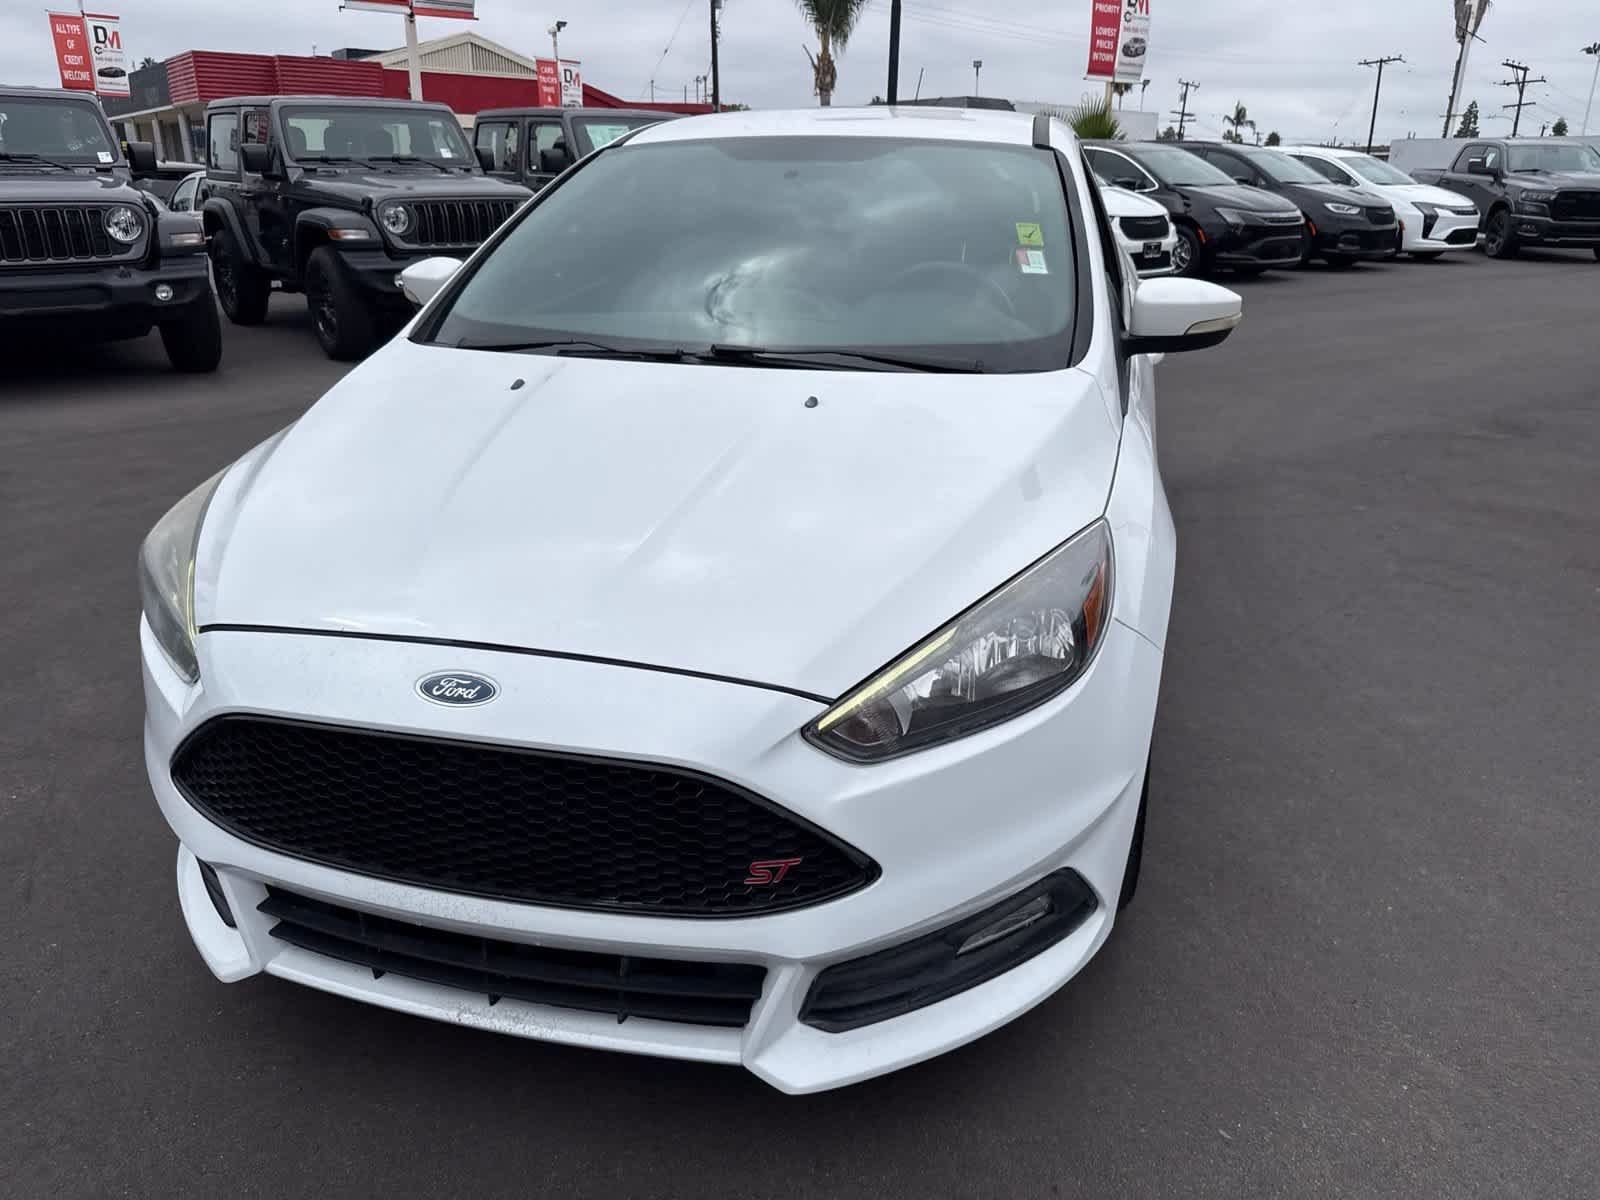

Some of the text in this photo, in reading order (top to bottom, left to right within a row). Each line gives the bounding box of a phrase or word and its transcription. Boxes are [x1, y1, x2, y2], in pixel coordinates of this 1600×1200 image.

[1095, 3, 1120, 14] PRIORITY
[56, 23, 81, 35] ALL TYPE
[1095, 26, 1117, 37] LOWEST
[67, 39, 75, 50] OF
[1096, 39, 1114, 50] PRICES
[63, 54, 84, 65] CREDIT
[62, 70, 90, 82] WELCOME
[432, 677, 481, 699] Ford
[744, 857, 802, 884] ST
